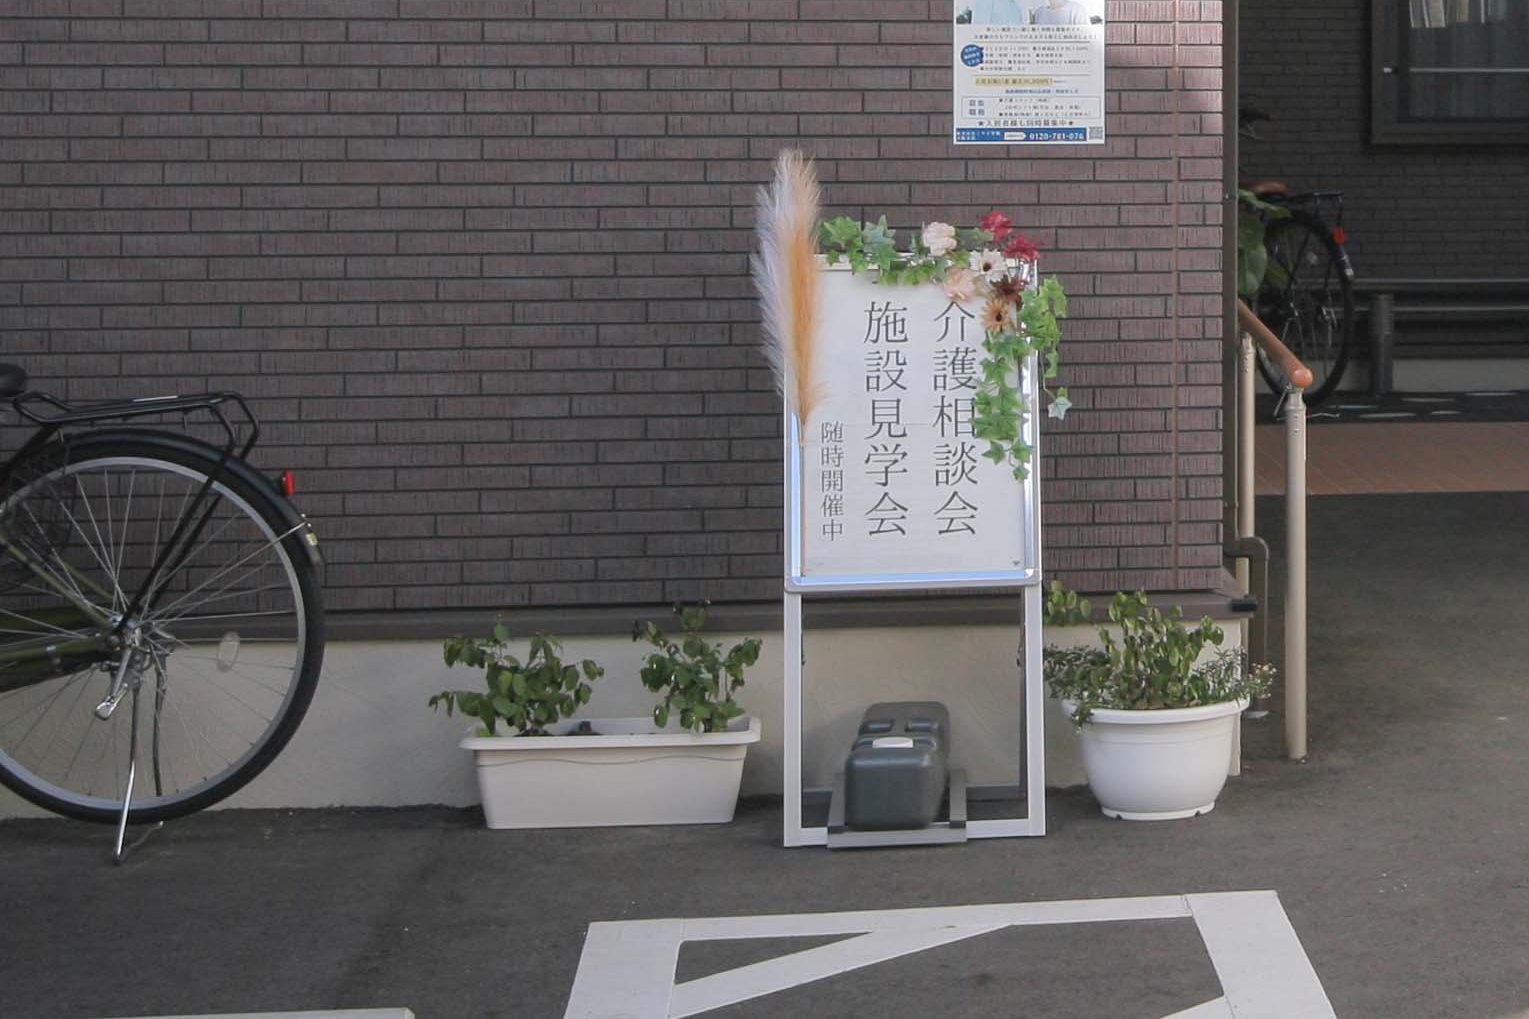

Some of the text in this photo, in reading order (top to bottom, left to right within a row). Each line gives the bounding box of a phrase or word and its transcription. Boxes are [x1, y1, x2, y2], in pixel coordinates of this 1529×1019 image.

[820, 421, 845, 541] 随時開催中
[864, 300, 908, 536] 施設見学会
[933, 300, 978, 535] 介護相談会
